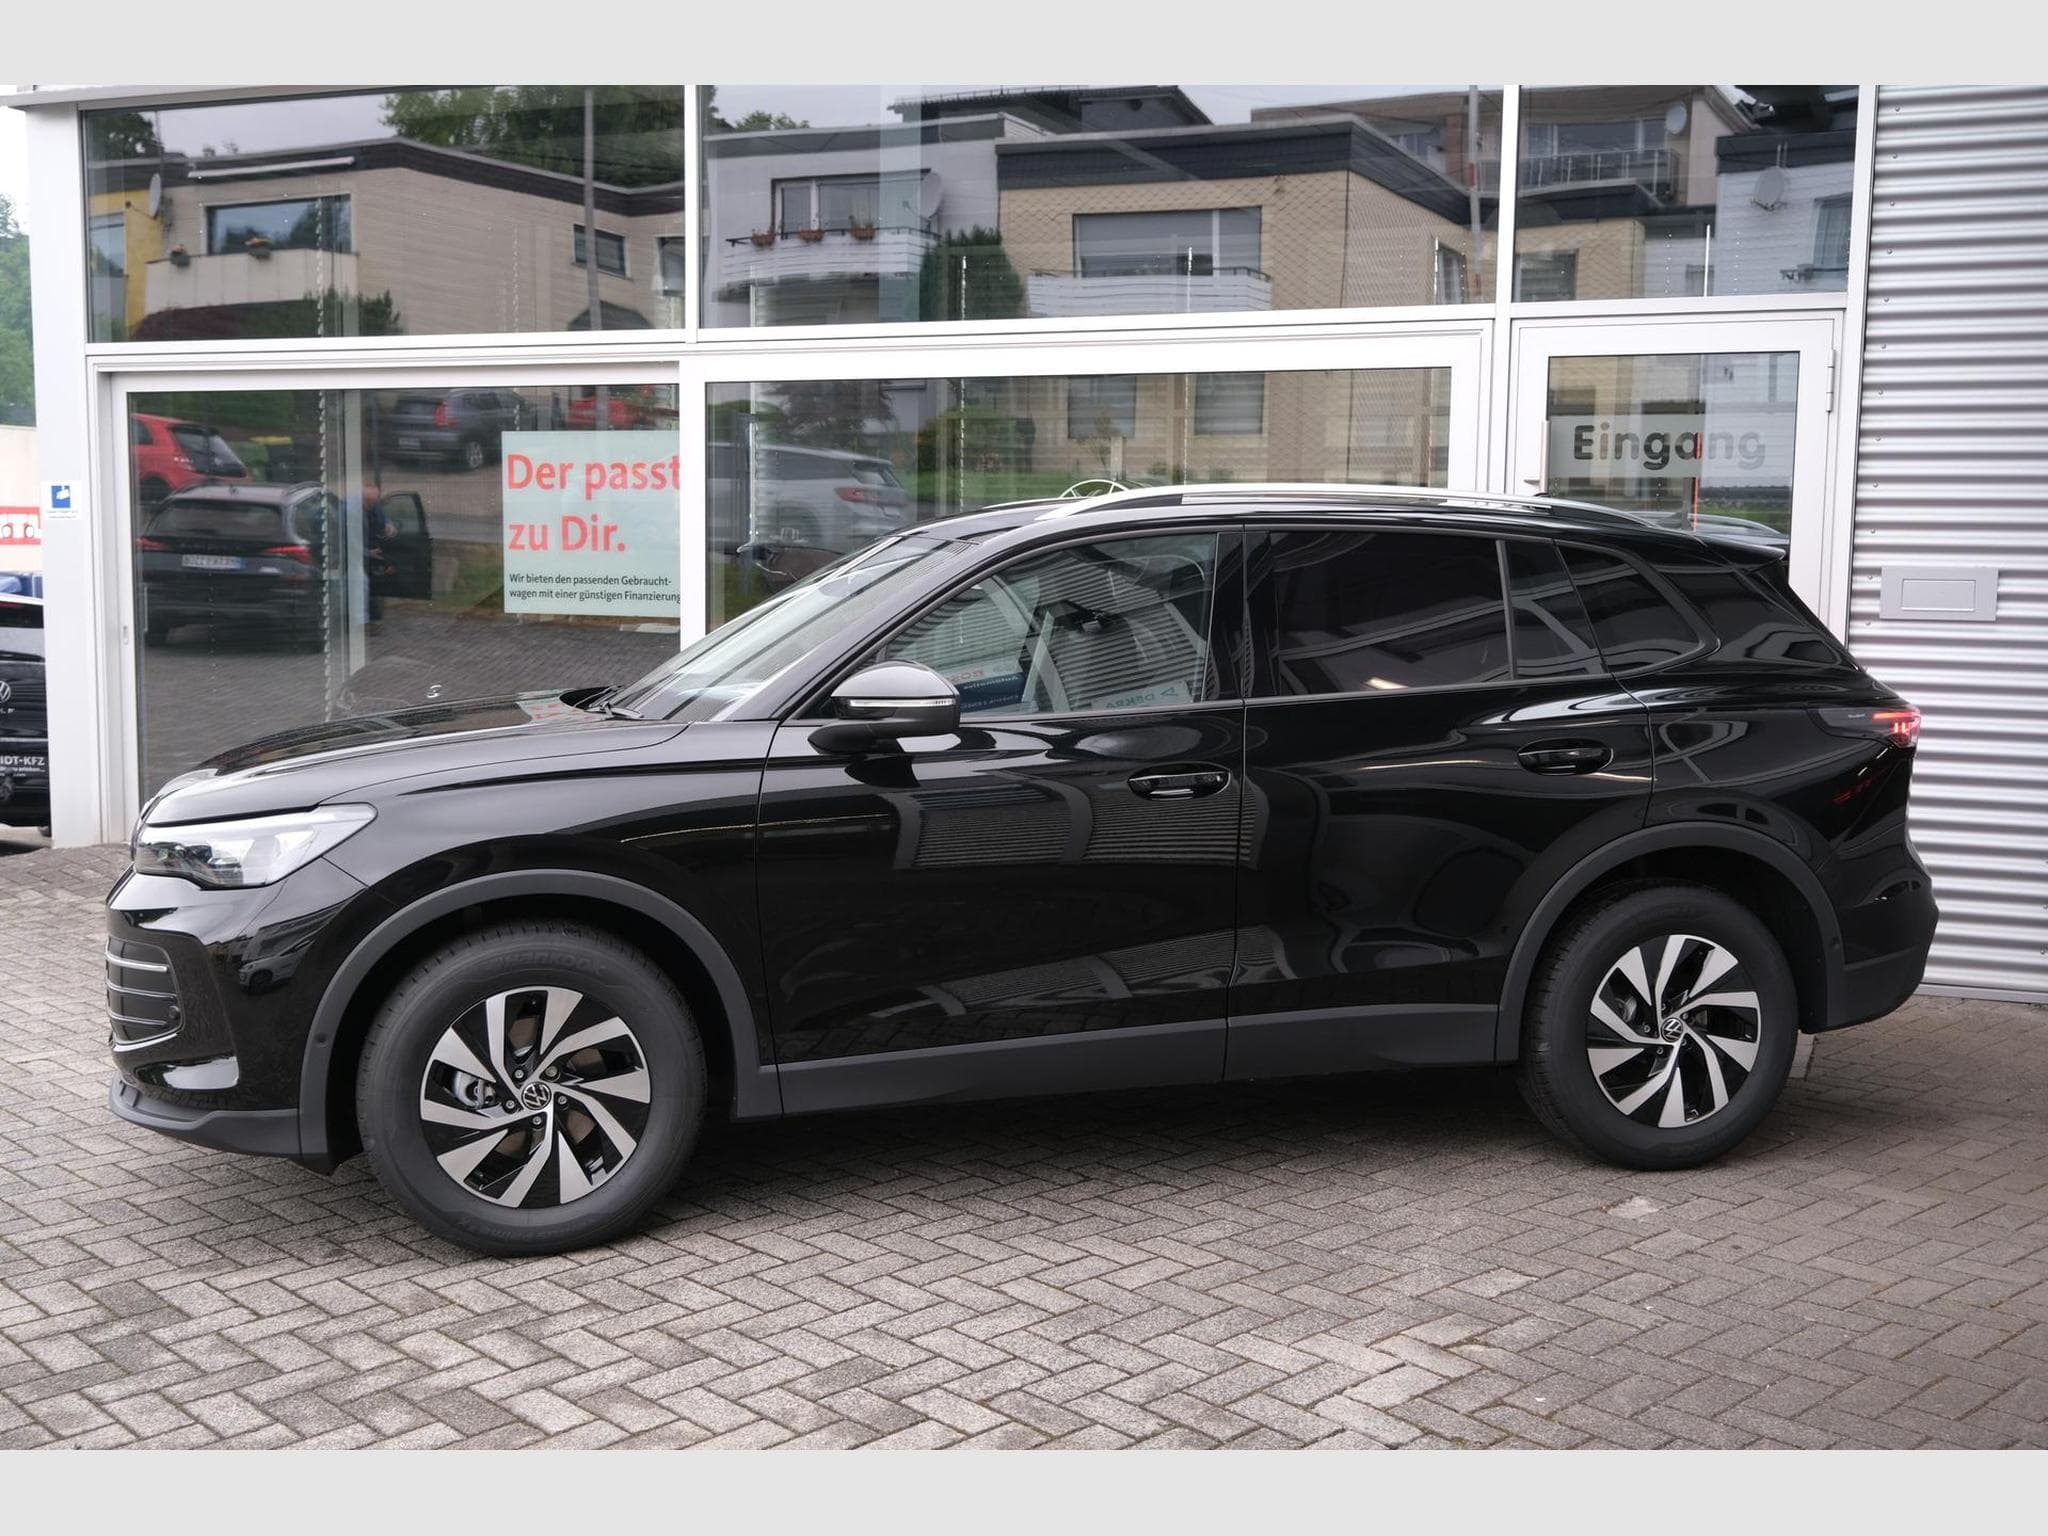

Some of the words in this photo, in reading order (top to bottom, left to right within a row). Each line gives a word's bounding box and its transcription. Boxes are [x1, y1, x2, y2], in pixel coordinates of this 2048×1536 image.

[1574, 421, 1766, 470] Eingang
[507, 454, 574, 490] Der
[584, 455, 680, 500] passt
[508, 524, 548, 551] zu
[561, 514, 626, 551] Dir.
[509, 573, 524, 583] Wir
[526, 573, 553, 584] bieten
[555, 573, 572, 584] den
[573, 575, 620, 586] passenden
[621, 575, 671, 586] Gebraucht-
[509, 590, 537, 600] wagen
[539, 589, 553, 598] mit
[554, 589, 577, 599] einer
[579, 589, 623, 602] günstigen
